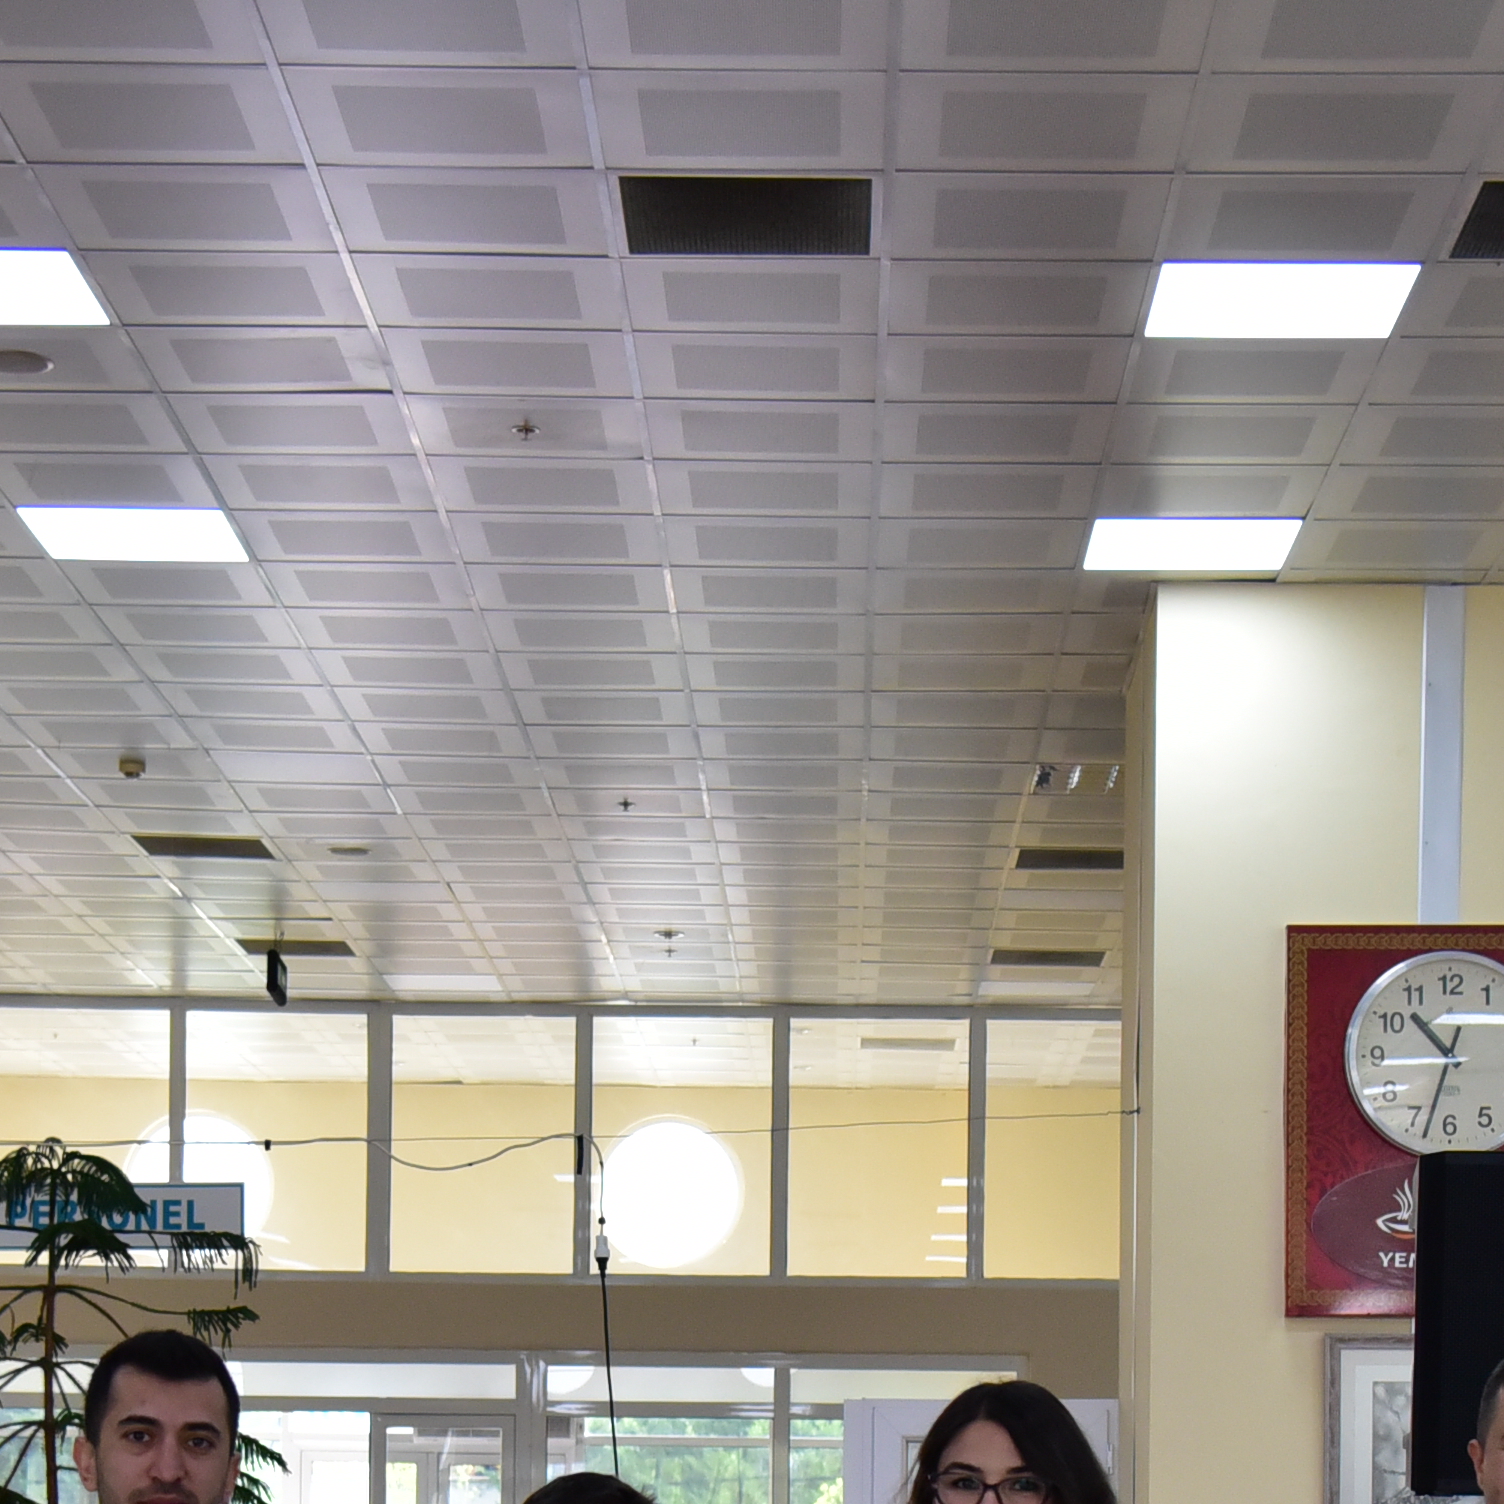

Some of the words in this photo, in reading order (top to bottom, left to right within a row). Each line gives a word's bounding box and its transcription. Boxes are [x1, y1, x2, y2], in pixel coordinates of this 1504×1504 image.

[1402, 984, 1424, 1006] 11
[1437, 973, 1464, 996] 12
[1480, 984, 1491, 1006] 1
[1378, 1011, 1405, 1034] 10
[1370, 1045, 1385, 1068] 9
[1407, 1105, 1422, 1128] 7
[1442, 1114, 1457, 1137] 6
[1477, 1106, 1493, 1128] 5
[10, 1199, 205, 1231] PERONEL
